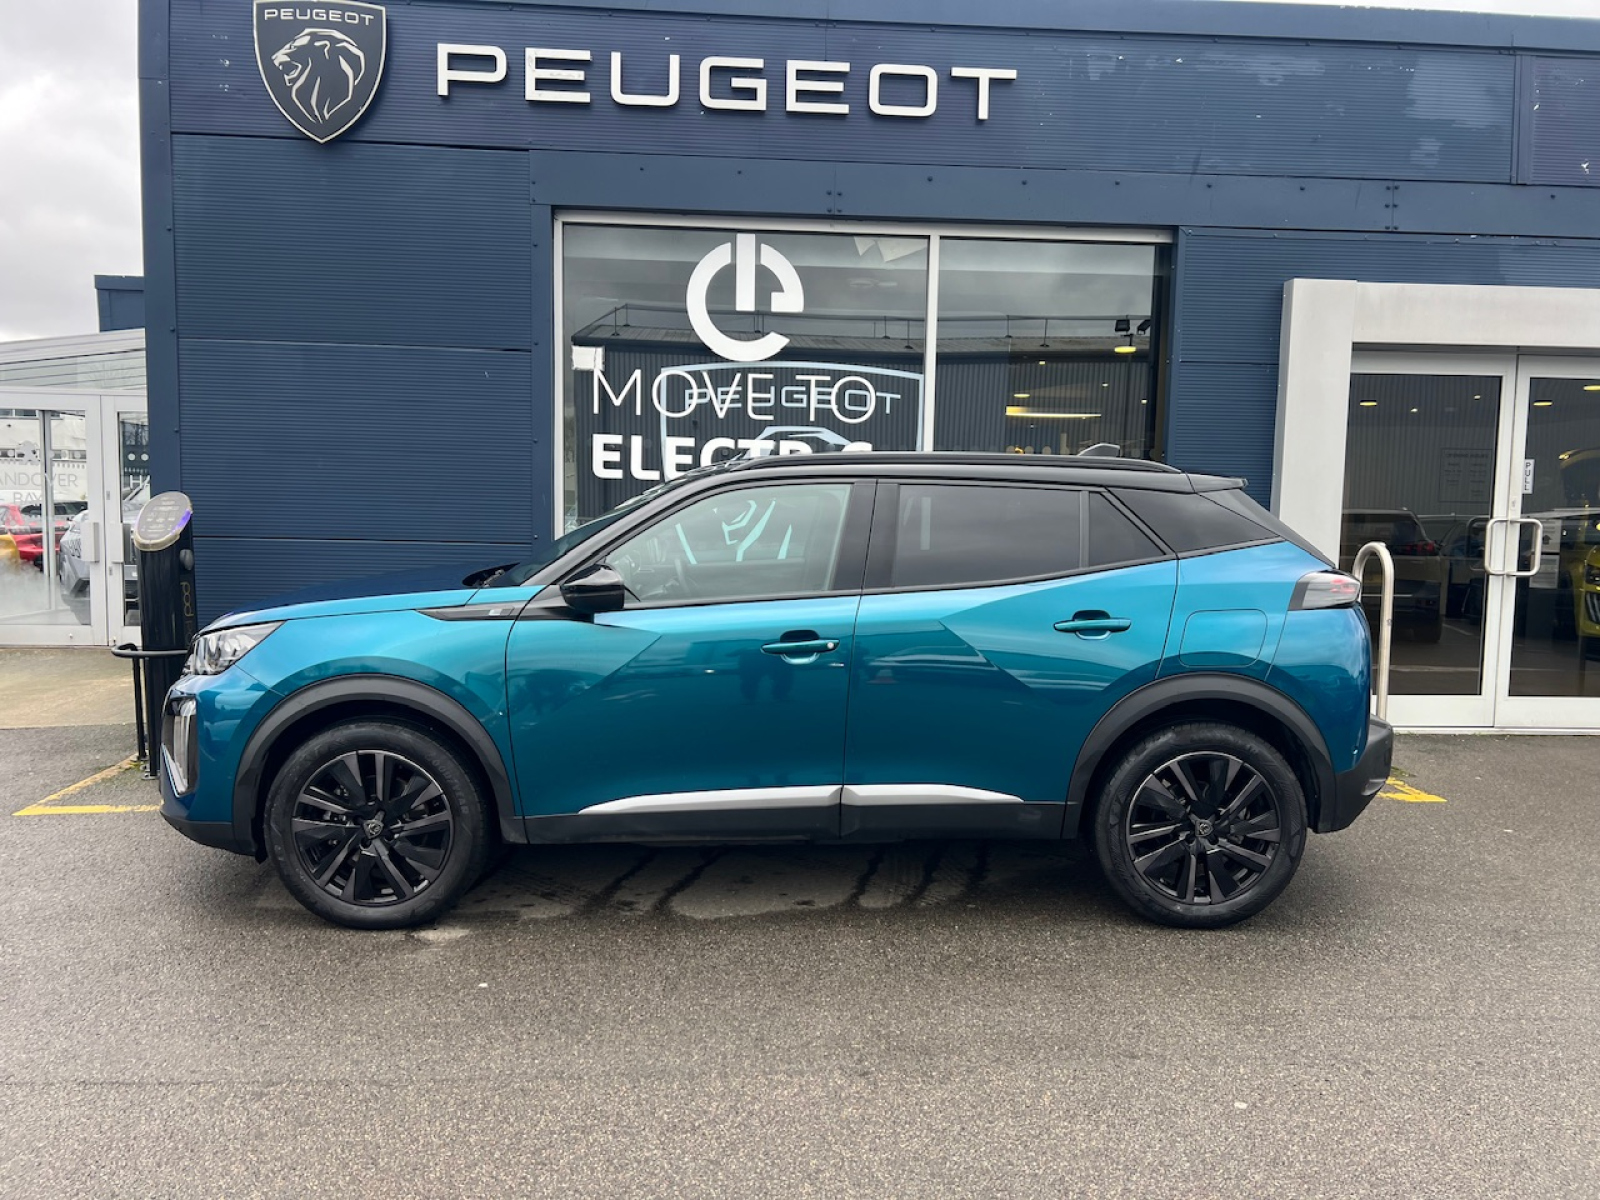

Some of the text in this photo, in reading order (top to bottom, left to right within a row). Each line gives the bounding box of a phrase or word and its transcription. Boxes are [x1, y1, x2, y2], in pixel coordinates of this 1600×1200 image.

[264, 8, 374, 26] PEUGEOT
[437, 43, 1018, 121] PEUGEOT
[593, 369, 876, 424] MOVE TO
[685, 385, 901, 415] PEUGEOT
[1524, 461, 1532, 491] PULL
